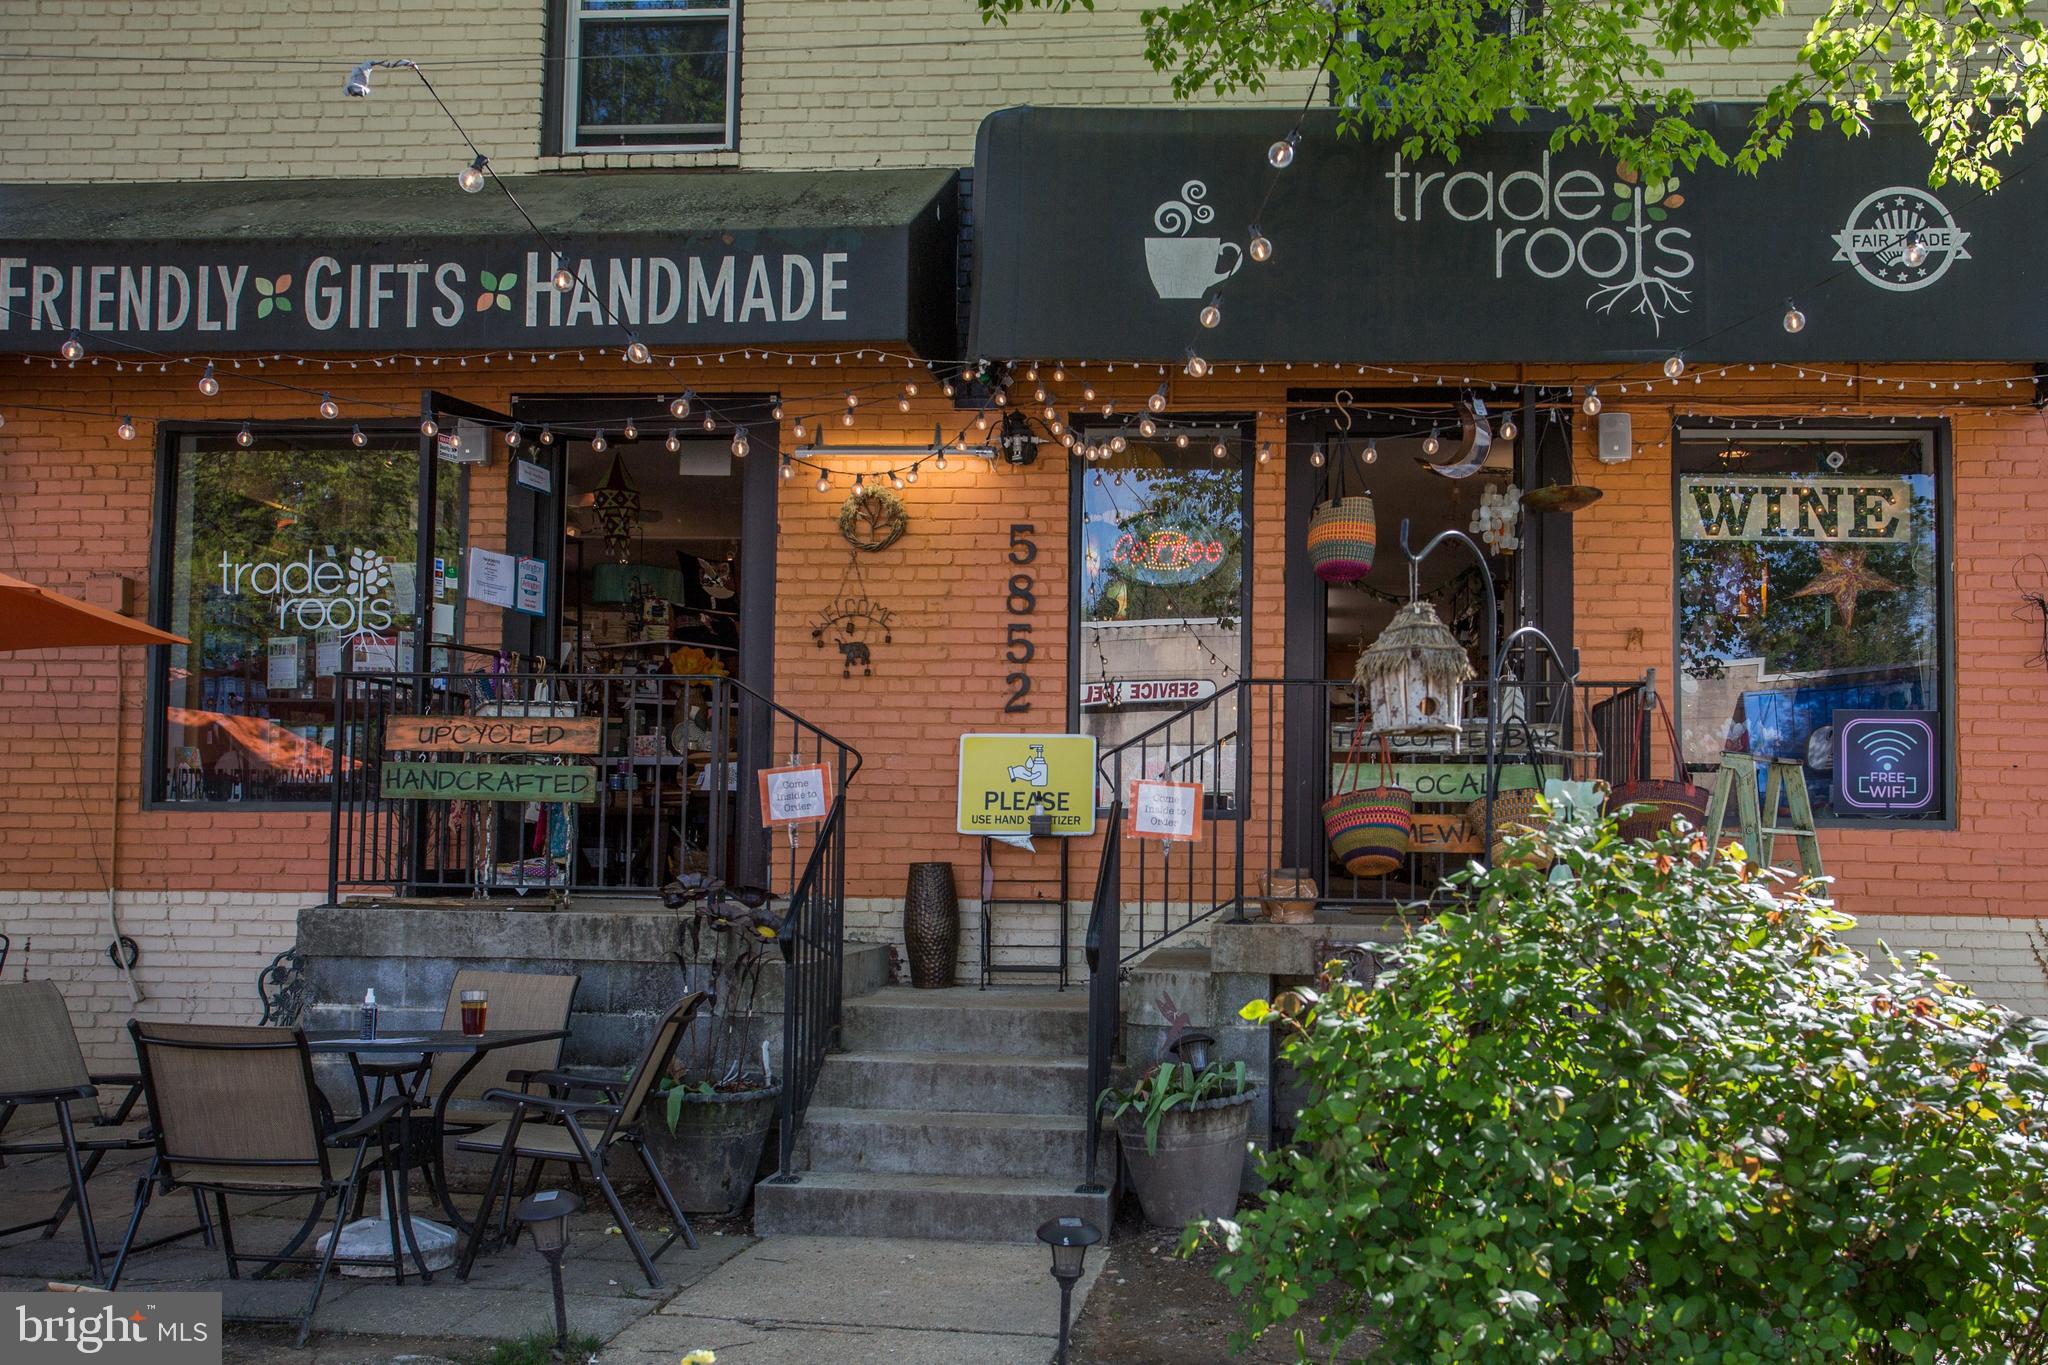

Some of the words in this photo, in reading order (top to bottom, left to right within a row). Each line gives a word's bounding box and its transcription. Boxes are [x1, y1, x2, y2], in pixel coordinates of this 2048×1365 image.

[1385, 150, 1605, 221] trade
[1496, 190, 1695, 284] roots
[1853, 234, 1889, 247] FAIR
[1896, 233, 1951, 246] TADE
[0, 257, 248, 331] FRIENDLY
[304, 256, 466, 330] GIFTS
[525, 250, 848, 327] HANDMADE
[1688, 485, 1900, 538] WINE
[218, 549, 344, 594] trade
[280, 575, 392, 633] roots
[418, 723, 565, 745] UPCYCLED
[1506, 728, 1560, 748] BAR
[386, 768, 590, 794] HANDCRAFTED
[782, 780, 809, 789] Come
[1870, 772, 1906, 783] FREE
[776, 792, 806, 801] Inside
[808, 790, 817, 798] to
[984, 791, 1070, 811] PLEASE
[1869, 785, 1906, 798] WIFI
[784, 803, 812, 813] Order
[971, 815, 992, 825] USE
[994, 815, 1025, 825] HAND
[1026, 815, 1081, 826] STIZER
